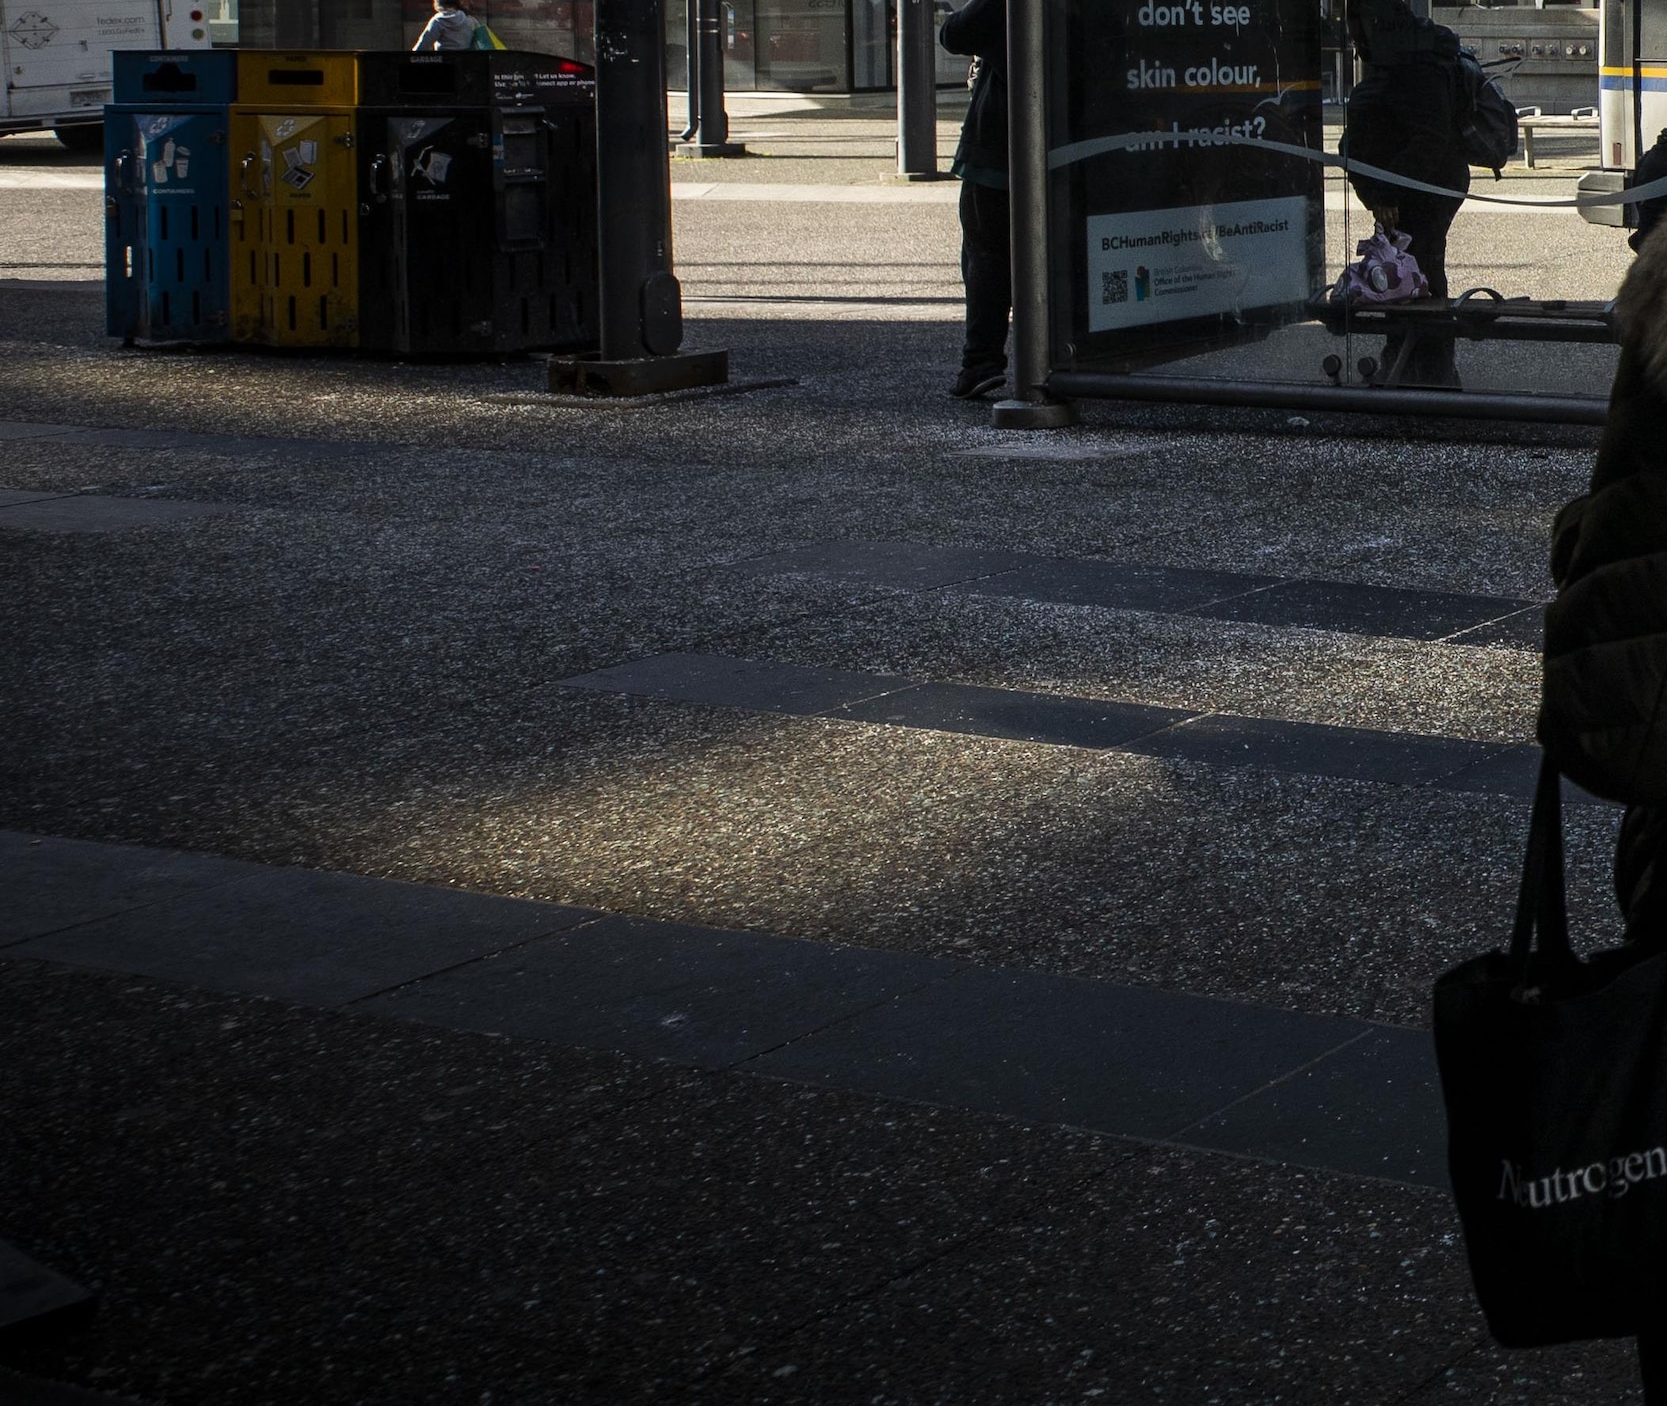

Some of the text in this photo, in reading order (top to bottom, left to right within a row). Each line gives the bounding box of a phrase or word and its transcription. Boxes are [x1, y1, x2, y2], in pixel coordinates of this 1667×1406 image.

[1210, 5, 1250, 26] see
[410, 55, 444, 64] GARBAGE
[1126, 57, 1262, 90] skin colour,
[1154, 277, 1173, 287] Office
[1173, 276, 1181, 285] of
[1181, 274, 1193, 283] the
[1194, 271, 1216, 282] Human
[1154, 284, 1199, 296] Commissioner
